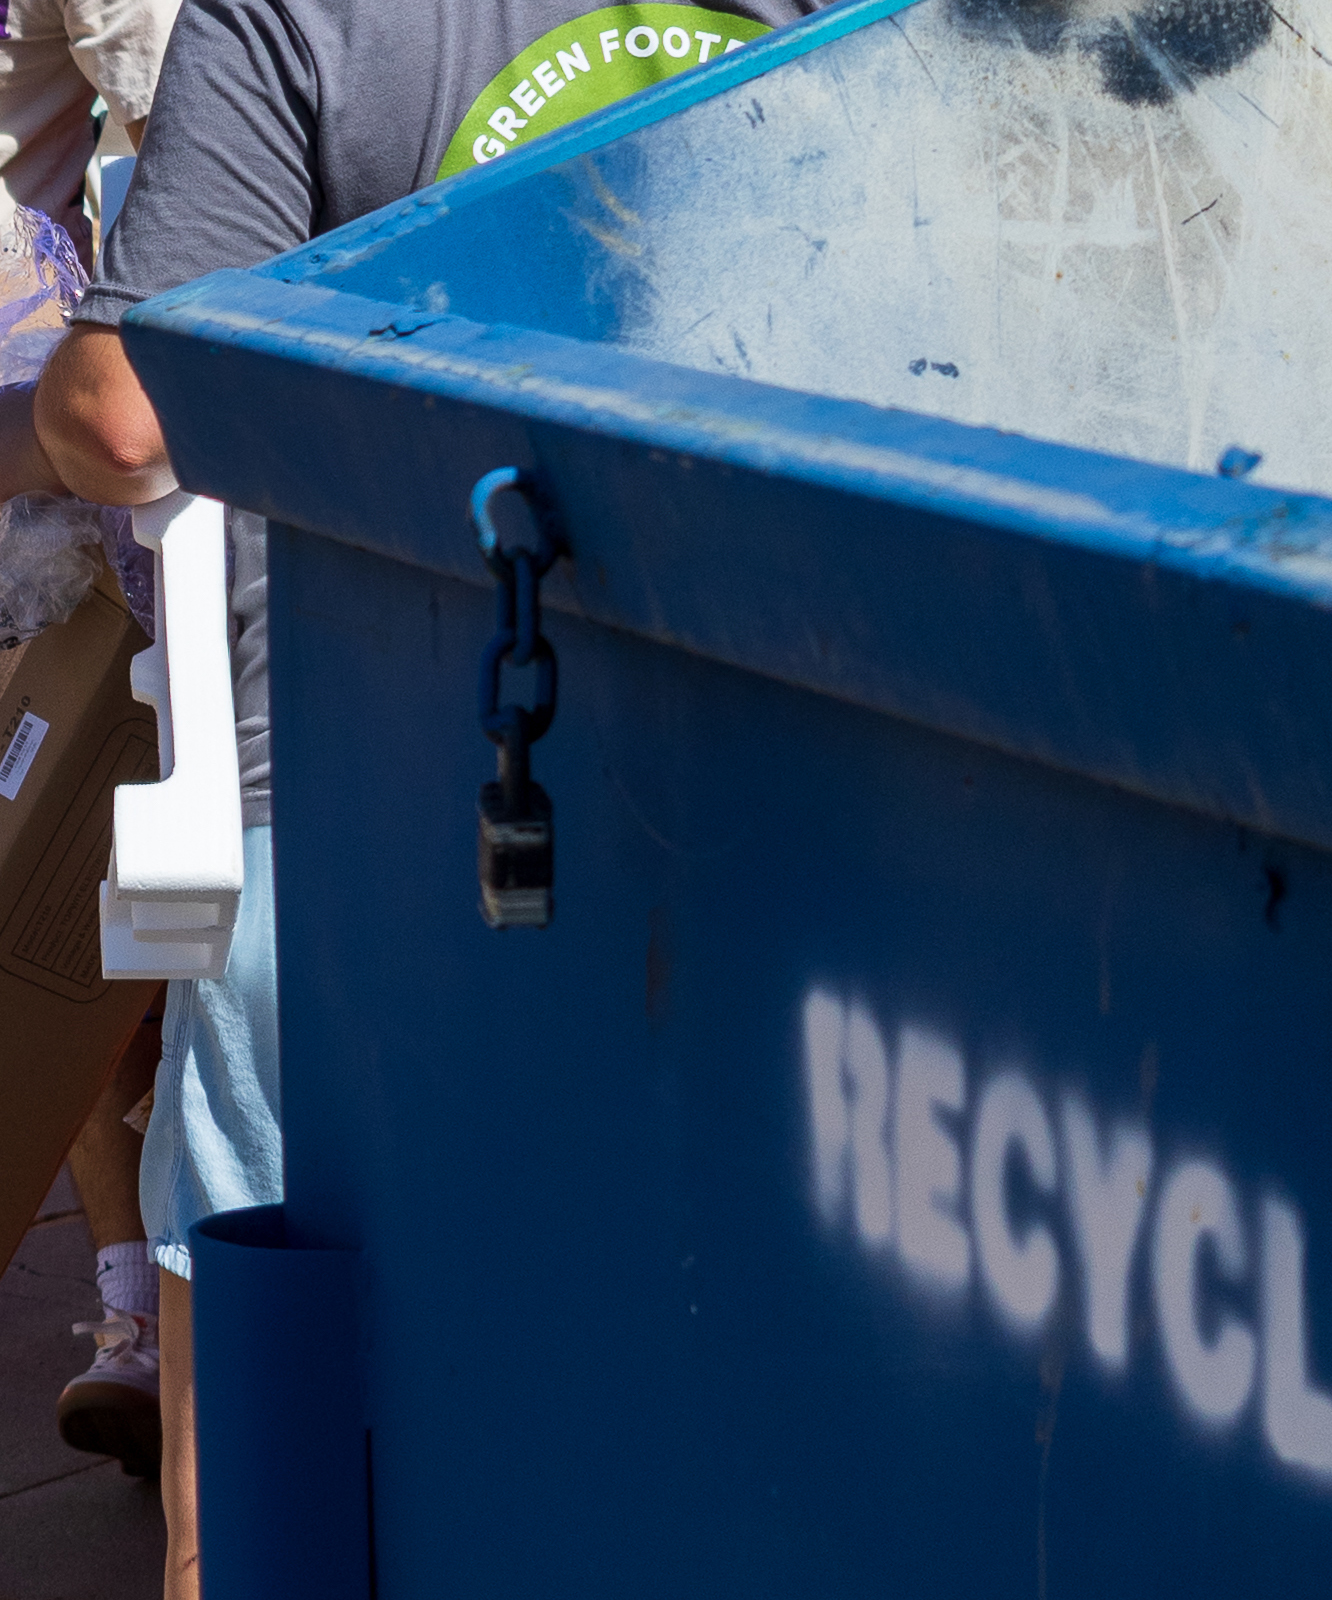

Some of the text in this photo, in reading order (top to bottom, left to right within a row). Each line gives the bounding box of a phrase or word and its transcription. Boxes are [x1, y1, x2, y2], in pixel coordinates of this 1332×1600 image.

[472, 42, 591, 164] GREEN
[0, 694, 34, 741] T210
[803, 988, 1332, 1475] RECYCL
